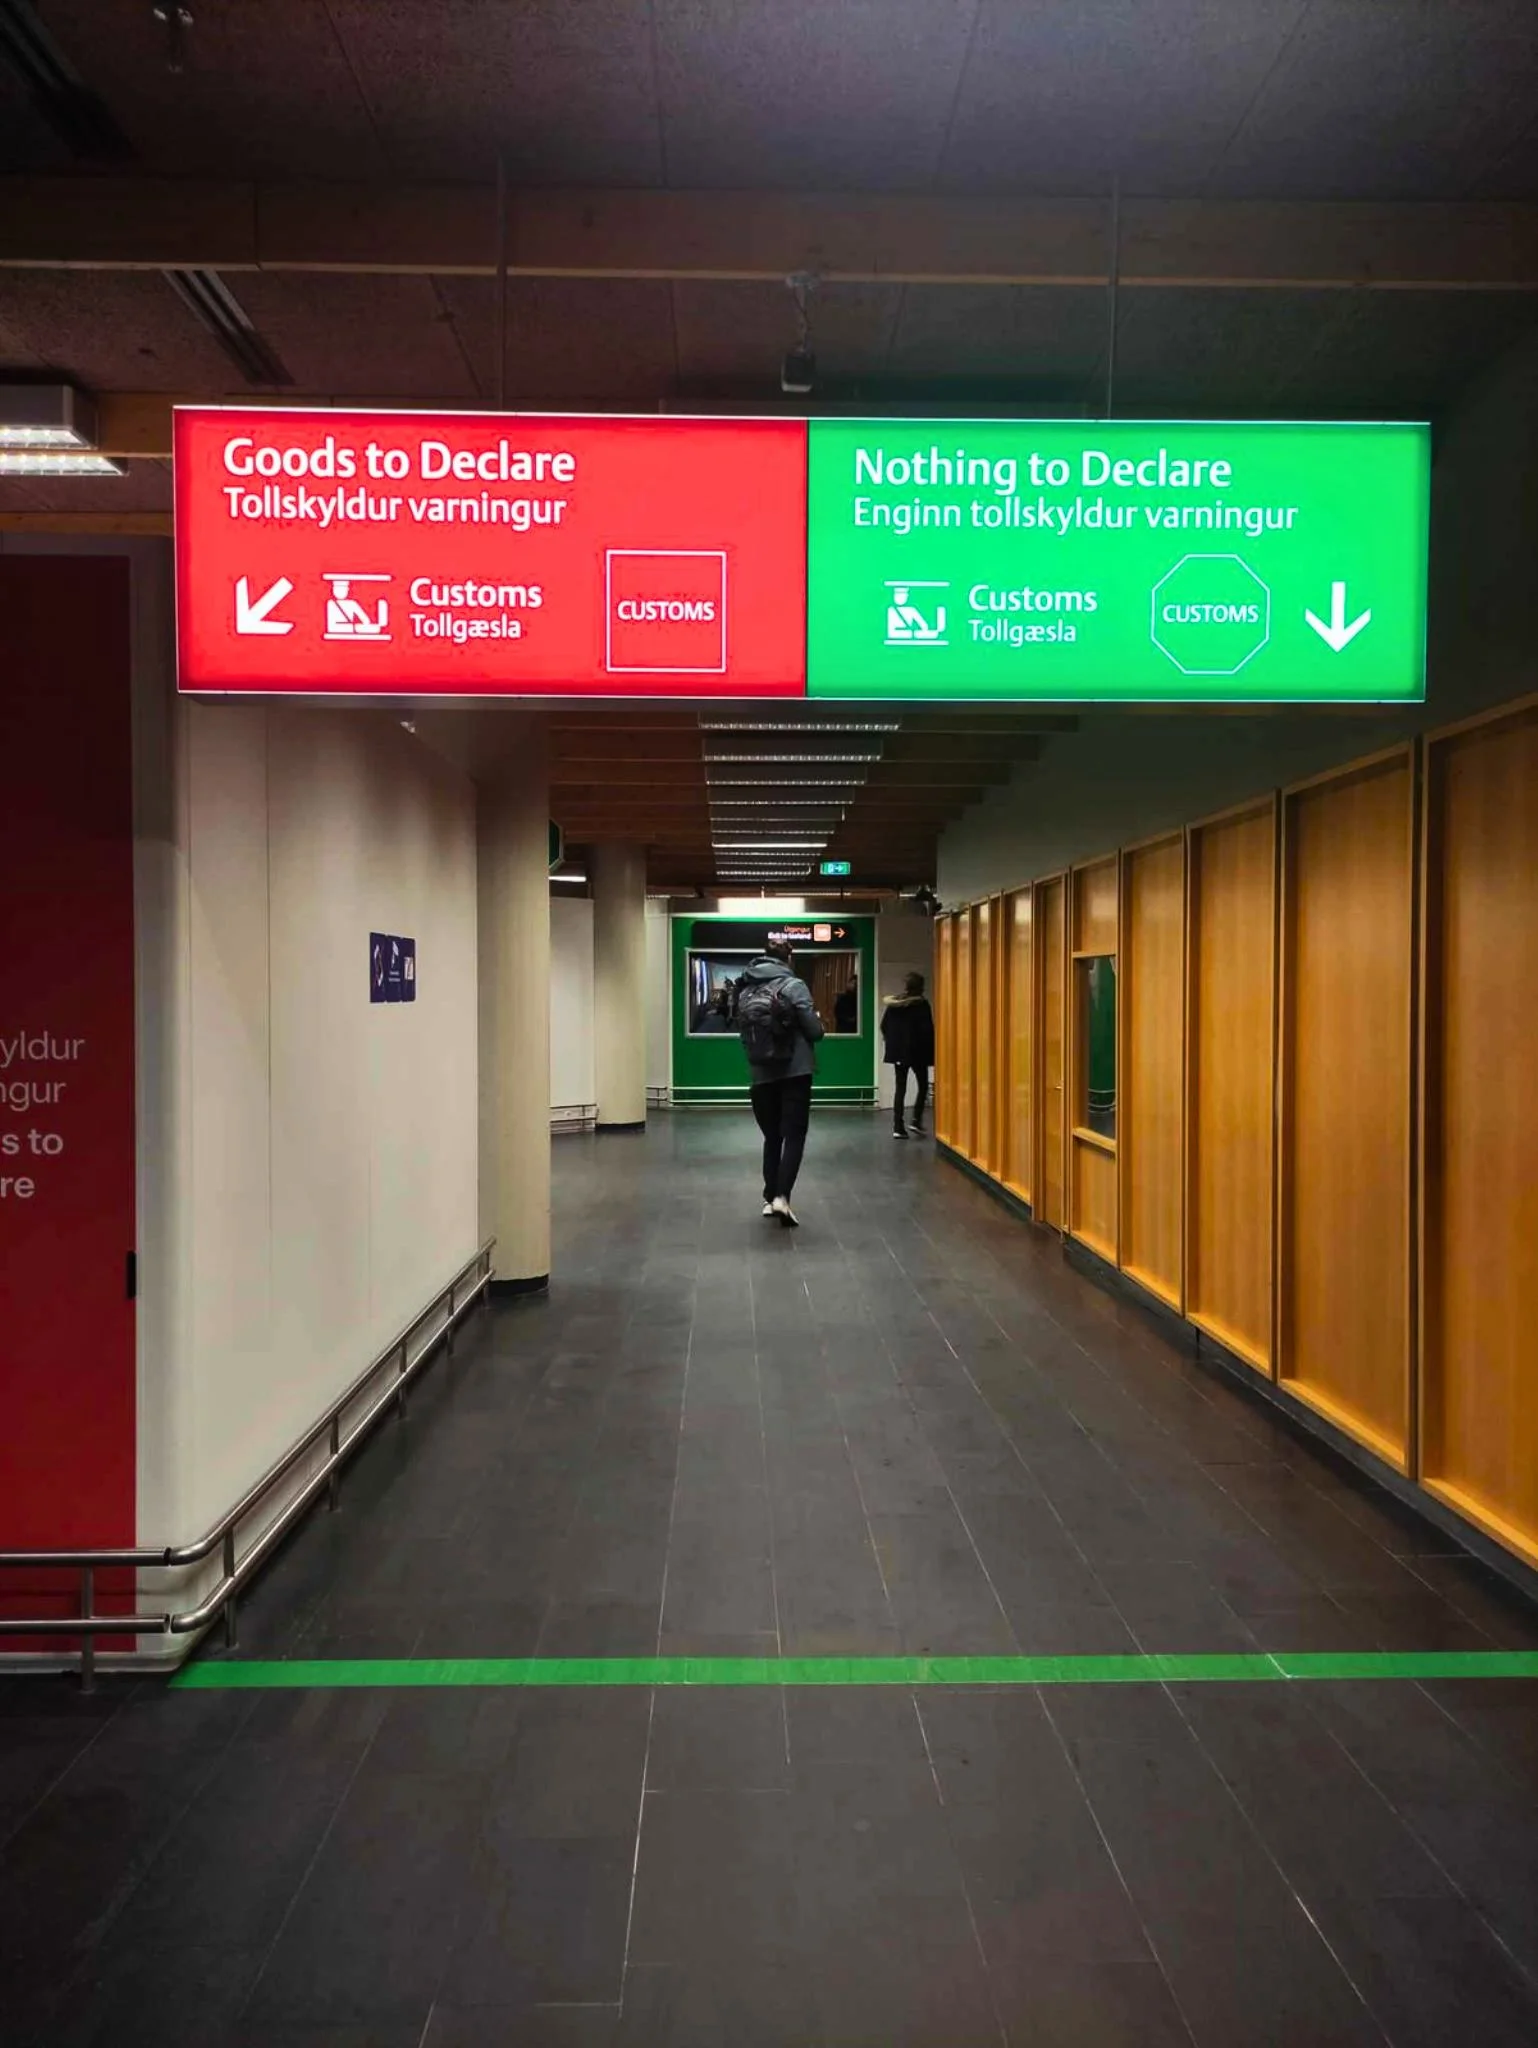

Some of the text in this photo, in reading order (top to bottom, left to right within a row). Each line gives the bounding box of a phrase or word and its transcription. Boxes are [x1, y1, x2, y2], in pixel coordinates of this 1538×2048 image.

[224, 437, 575, 482] Goods to Declare
[856, 447, 1231, 496] Nothing to Declare
[223, 487, 567, 531] Tollskyldur varningur
[855, 497, 1296, 537] Enginn tollskyldur varningur
[410, 578, 542, 608] Customs
[969, 585, 1097, 611] Customs
[617, 601, 715, 621] CUSTOMS
[1163, 605, 1258, 623] CUSTOMS
[410, 613, 521, 643] Tollgæsla
[971, 619, 1076, 647] Tollgæsla
[27, 1128, 65, 1155] to
